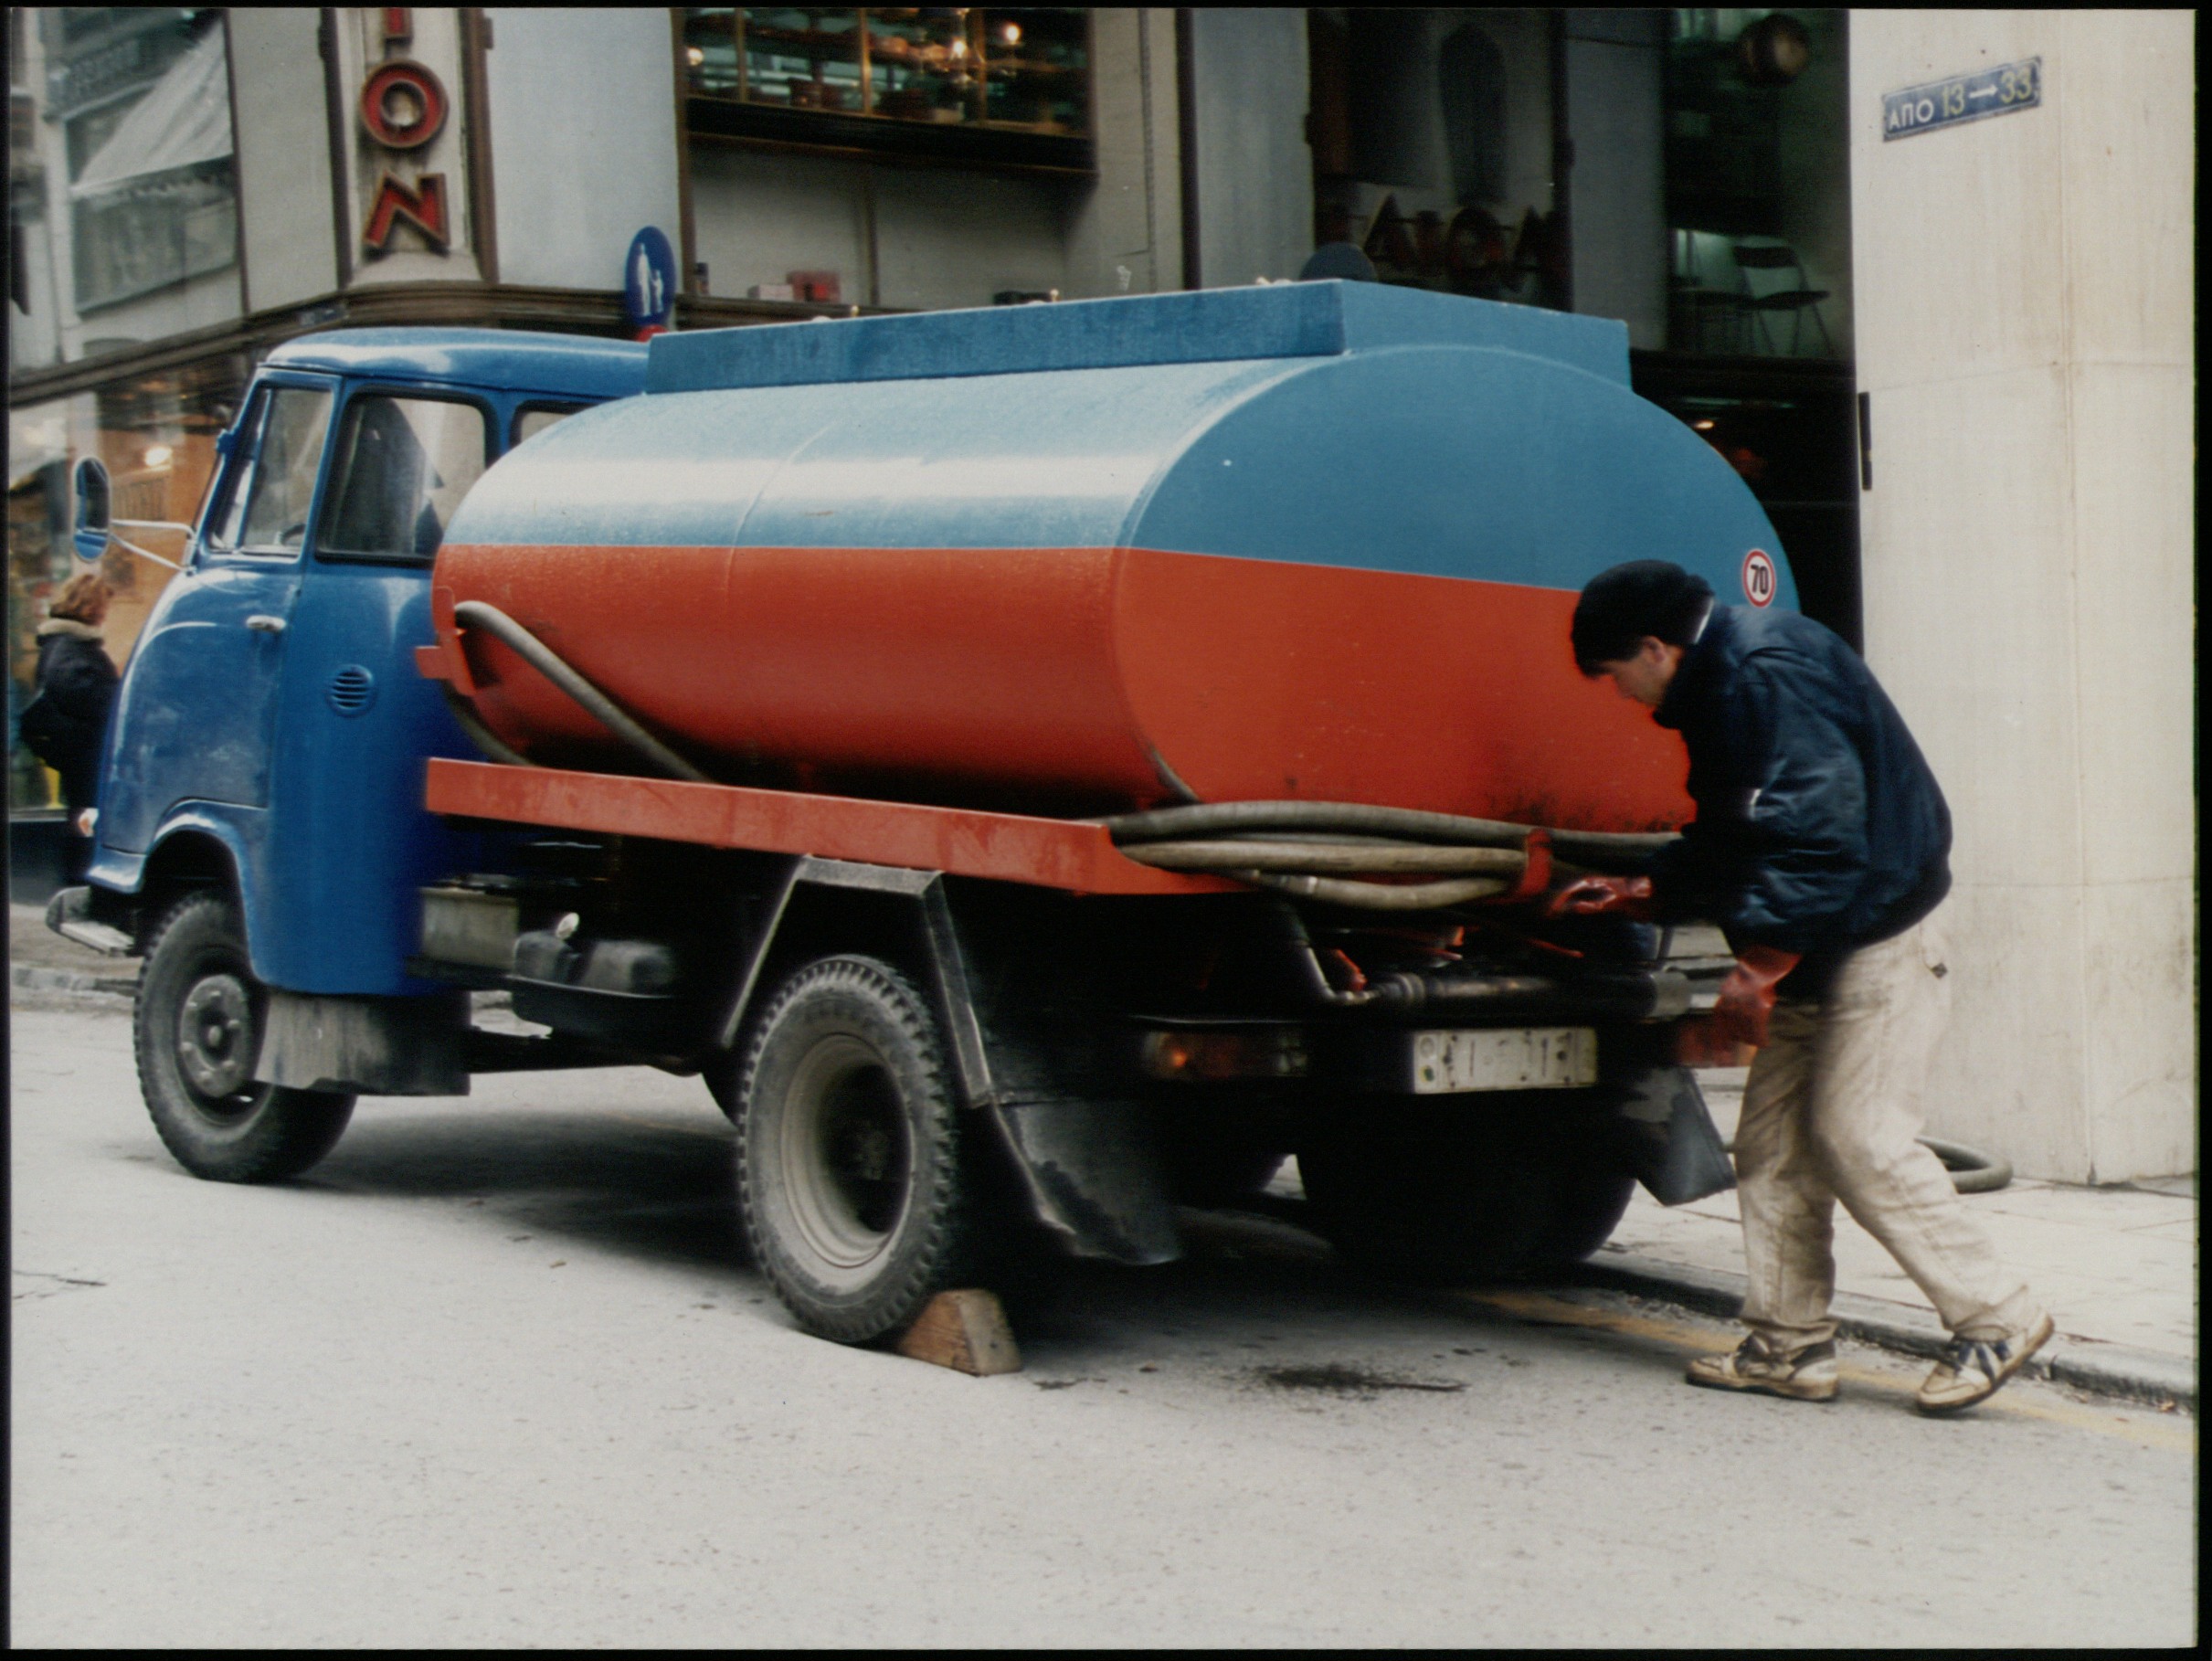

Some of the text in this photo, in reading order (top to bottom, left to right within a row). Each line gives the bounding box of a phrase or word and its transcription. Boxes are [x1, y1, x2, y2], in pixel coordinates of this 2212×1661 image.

[1889, 67, 2033, 130] ΑΠΟ 13 33
[1751, 564, 1769, 595] 70
